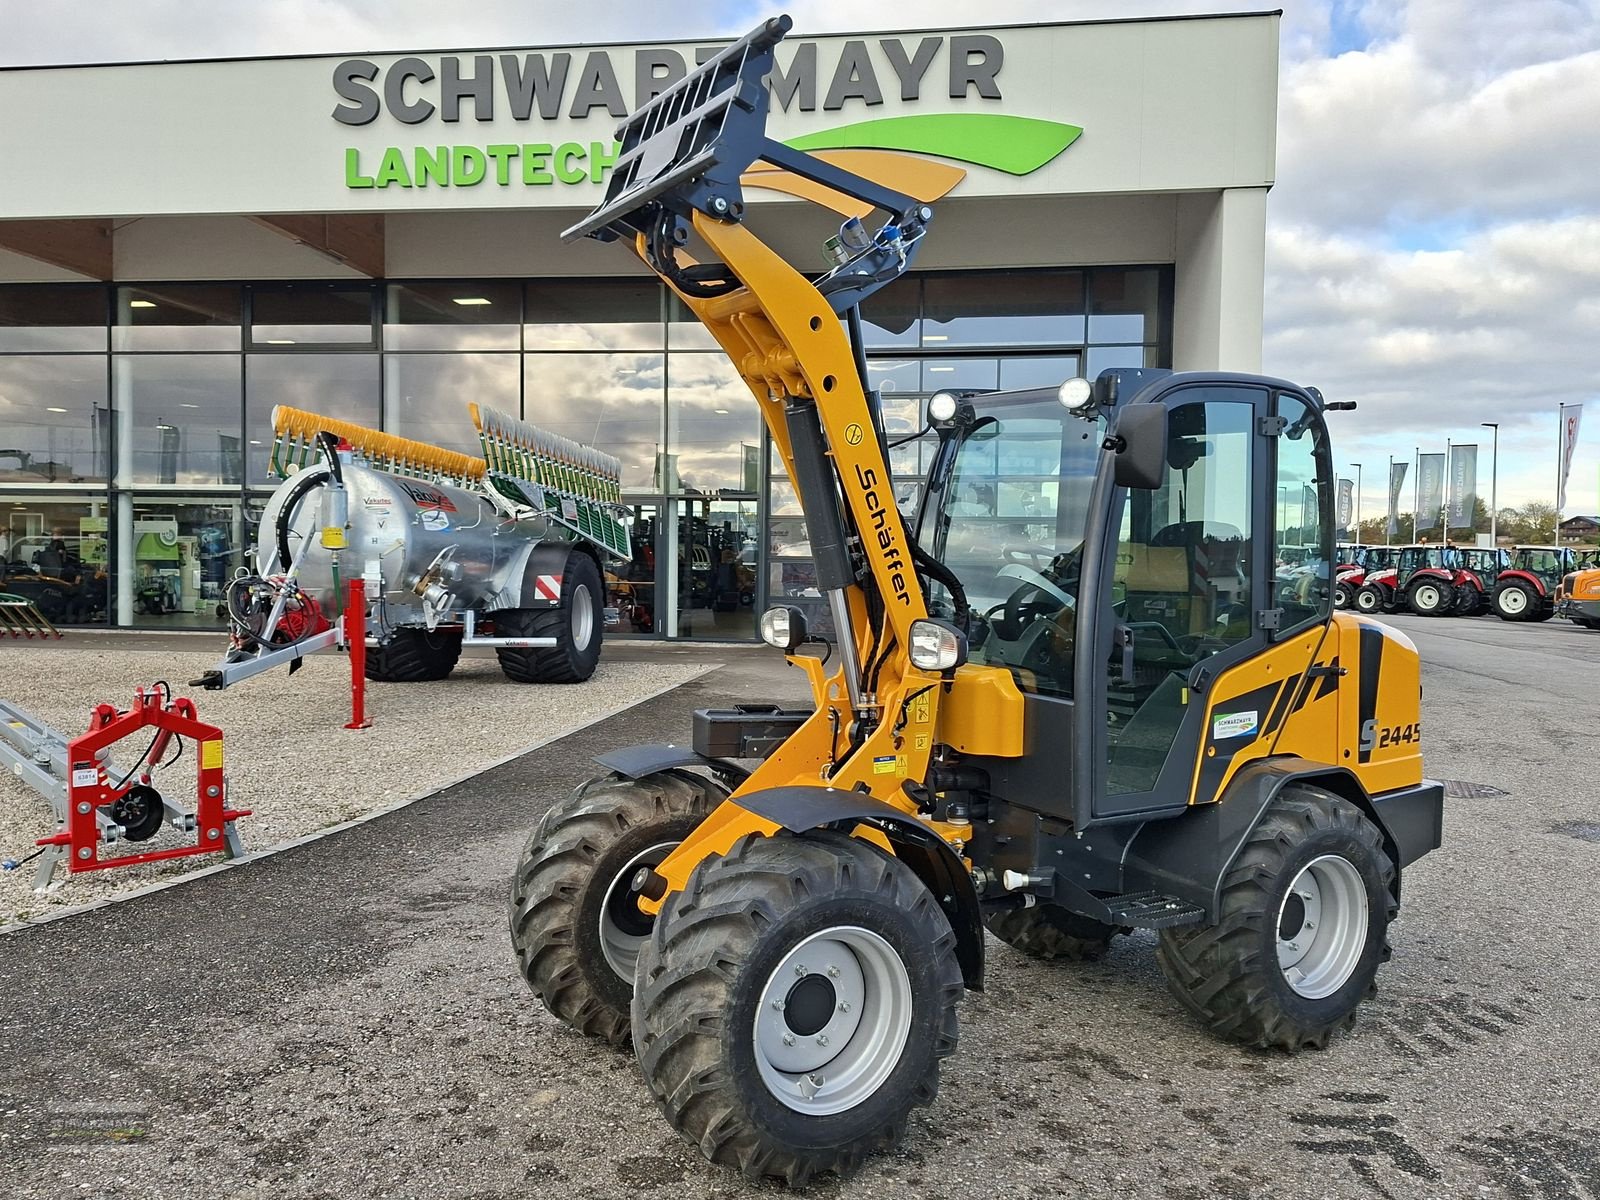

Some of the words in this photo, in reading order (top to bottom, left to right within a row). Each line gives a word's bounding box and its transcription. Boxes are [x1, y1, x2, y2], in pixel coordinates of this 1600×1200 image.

[332, 34, 1004, 126] SCHWARMAYR
[363, 497, 392, 505] Vakutec
[1455, 462, 1465, 517] SCHWARZMAYR
[1340, 496, 1349, 524] CASE
[854, 463, 911, 607] Schäffer
[1218, 717, 1252, 726] SCHWARZMAYR
[1359, 719, 1378, 751] S
[1379, 723, 1420, 748] 2445
